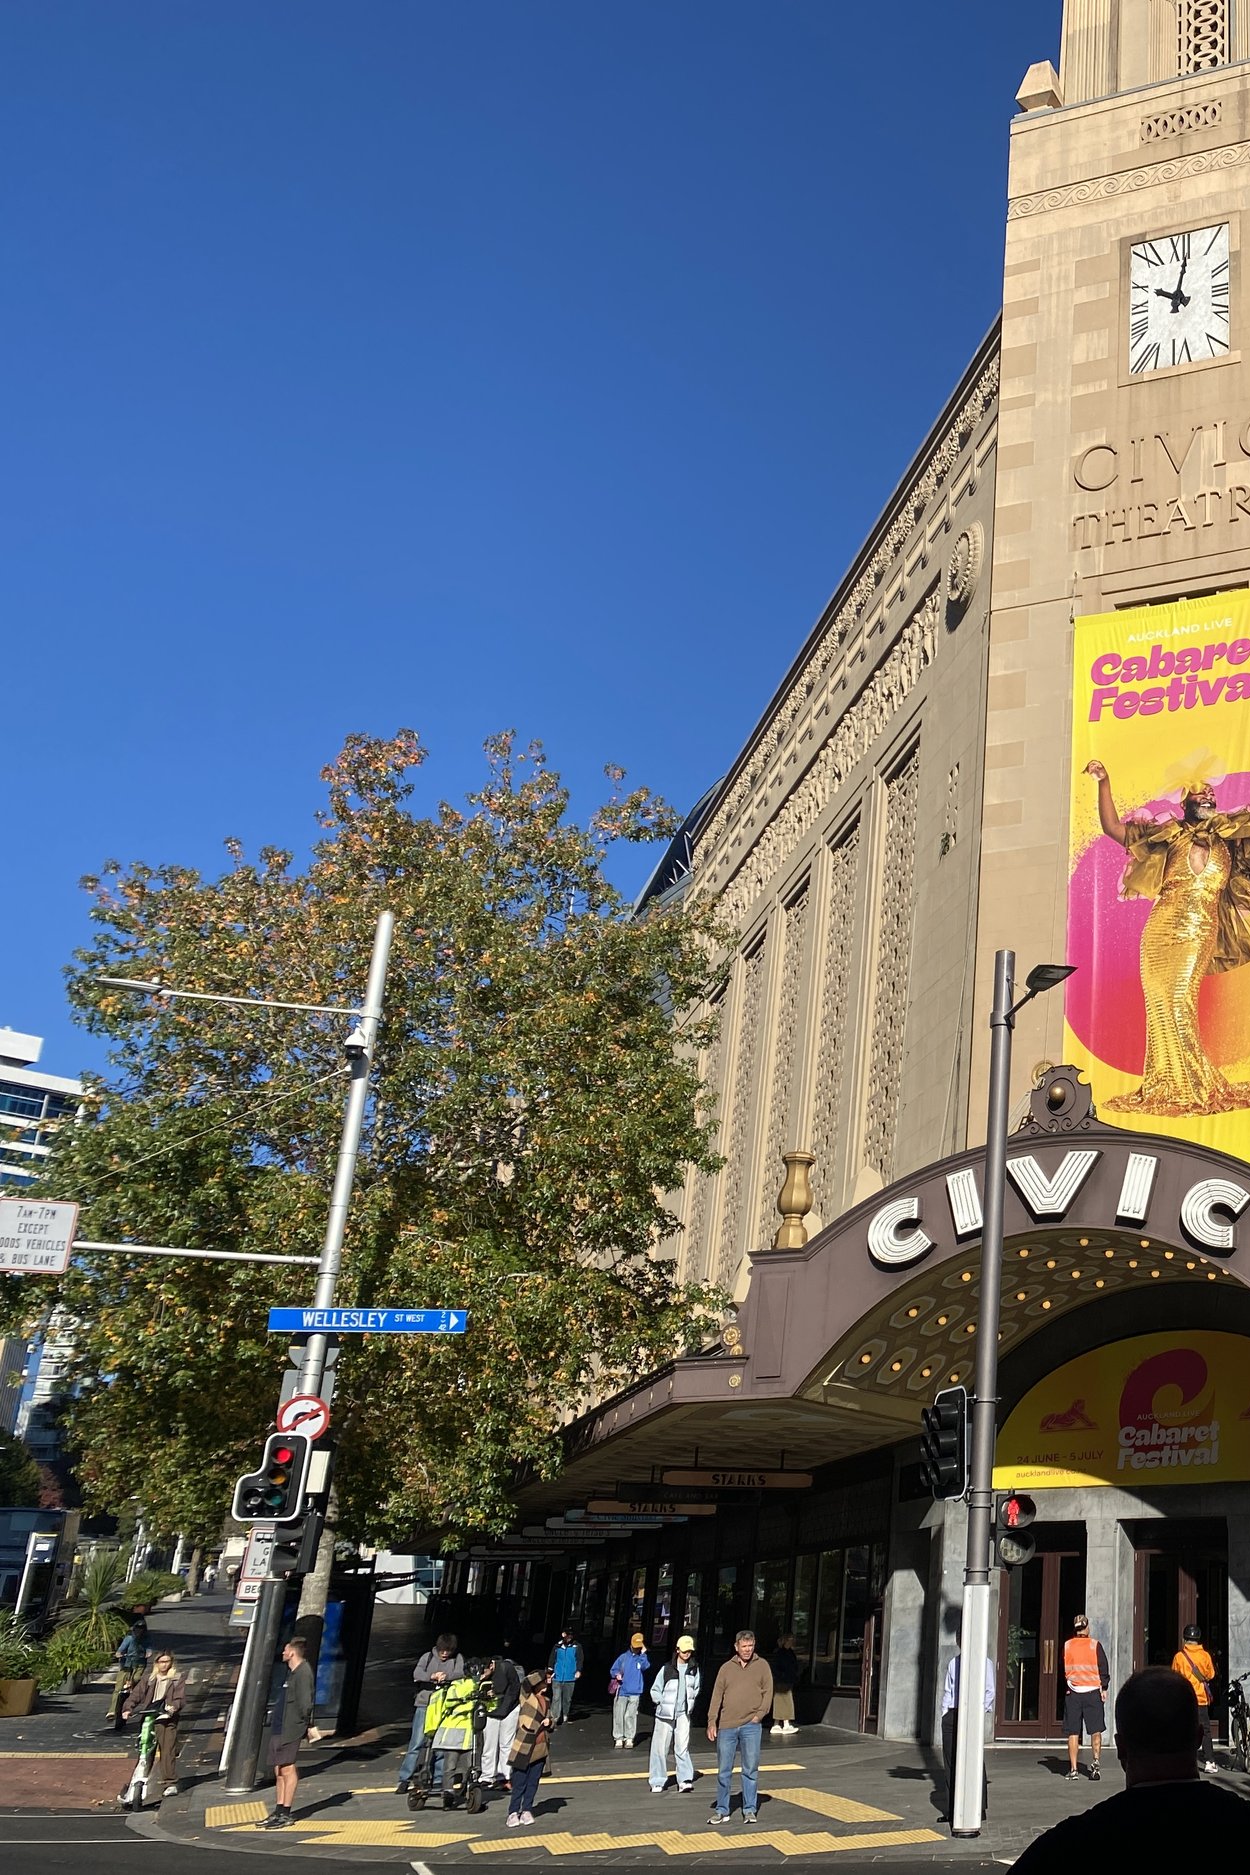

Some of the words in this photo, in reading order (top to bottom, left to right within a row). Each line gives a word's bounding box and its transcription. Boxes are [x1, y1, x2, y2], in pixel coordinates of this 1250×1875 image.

[1127, 624, 1200, 642] AUCKLAND
[1203, 617, 1233, 631] LIVE
[17, 1222, 49, 1235] EXCEPT
[0, 1237, 20, 1249] OODS
[26, 1238, 66, 1252] VEHICLES
[11, 1253, 28, 1265] BUS
[33, 1255, 56, 1267] LANE
[302, 1311, 388, 1328] WELLESLEY
[394, 1314, 404, 1323] ST
[405, 1314, 425, 1323] WEST
[1137, 1411, 1178, 1421] AUCKLAND
[1181, 1410, 1200, 1418] LIVE
[1117, 1421, 1220, 1448] Cabaret
[1016, 1455, 1029, 1465] 24
[1031, 1453, 1059, 1464] JUNE
[1070, 1452, 1076, 1461] 5
[1076, 1450, 1104, 1461] JULY
[1116, 1440, 1220, 1470] Festival
[711, 1474, 766, 1486] STARKS
[629, 1503, 676, 1513] STARKS
[253, 1557, 267, 1567] LA
